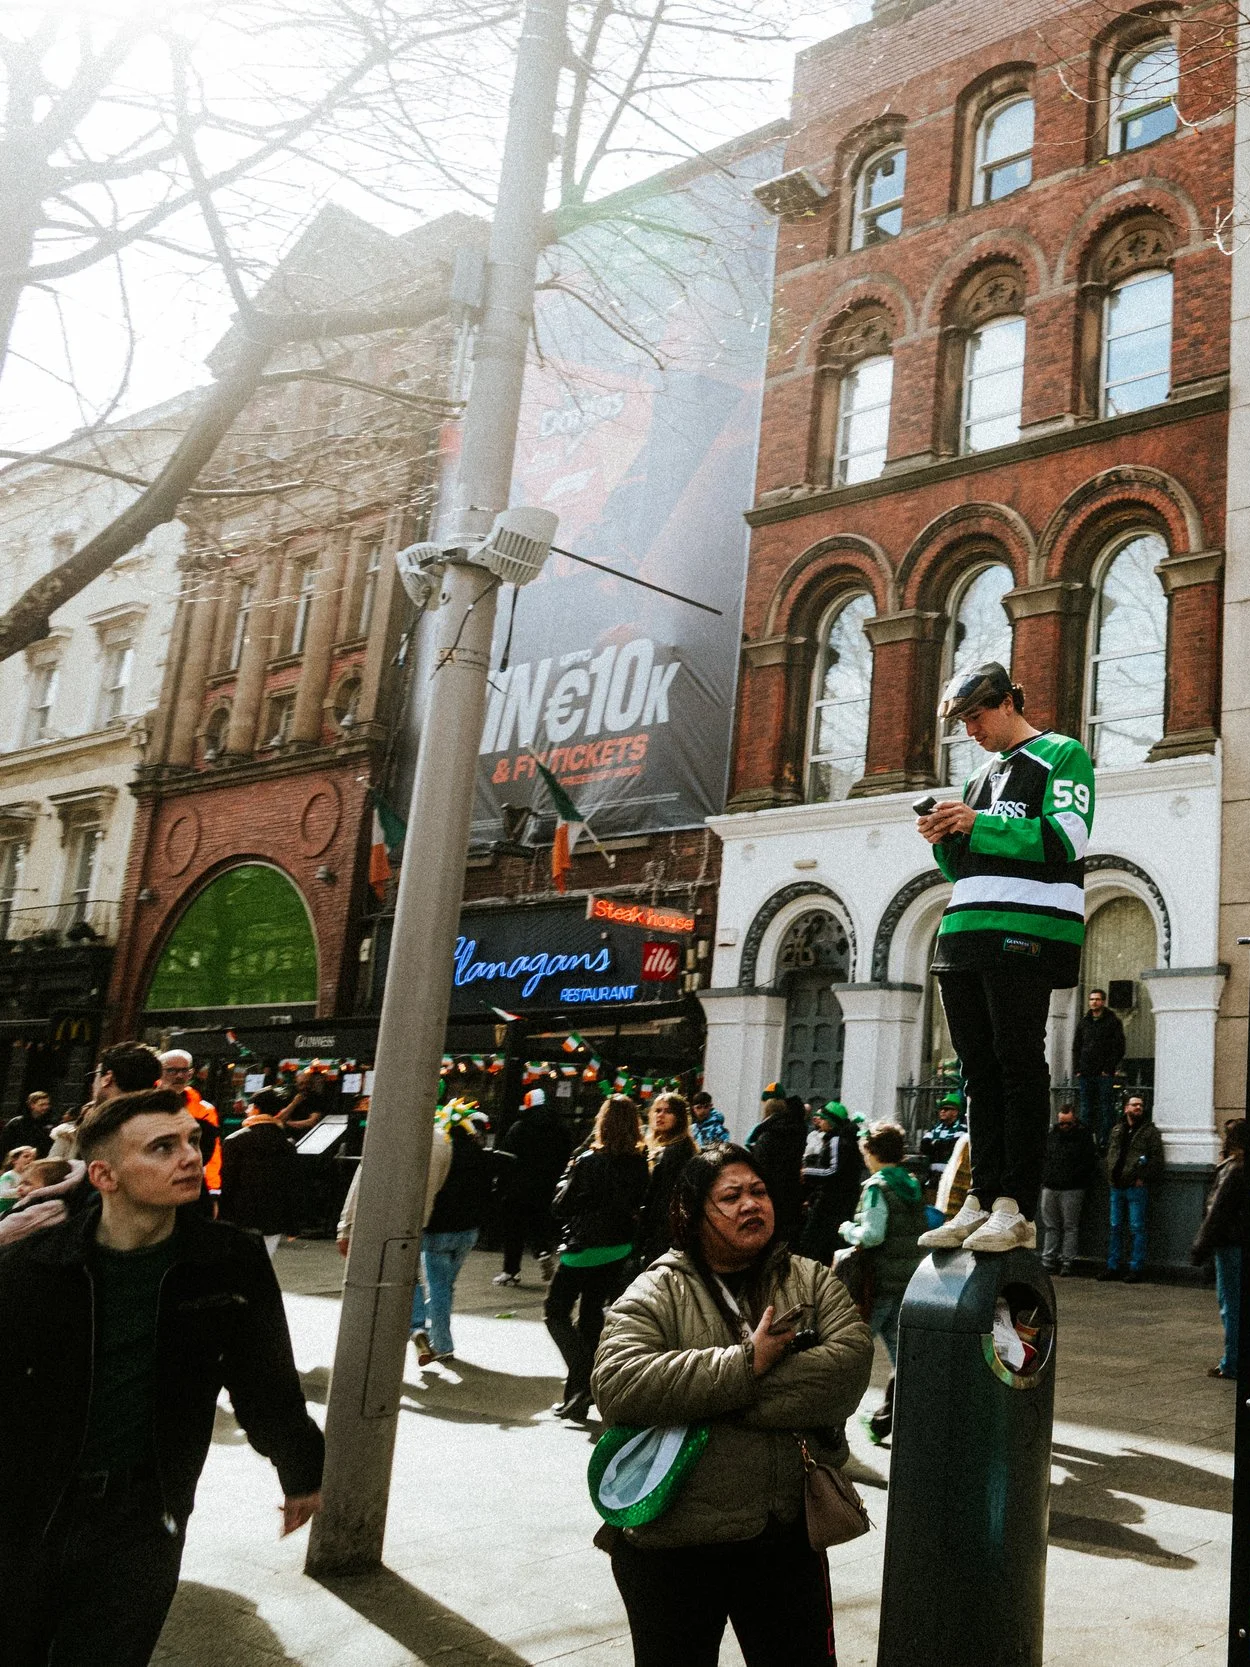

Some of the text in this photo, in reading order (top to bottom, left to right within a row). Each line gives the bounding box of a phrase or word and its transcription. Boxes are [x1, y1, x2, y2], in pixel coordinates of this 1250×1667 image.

[492, 758, 510, 784] &
[551, 734, 649, 774] TICKETS
[1052, 779, 1090, 814] 59
[594, 899, 695, 931] Steak house
[644, 946, 677, 979] illy
[560, 984, 638, 1003] RESTAURANT
